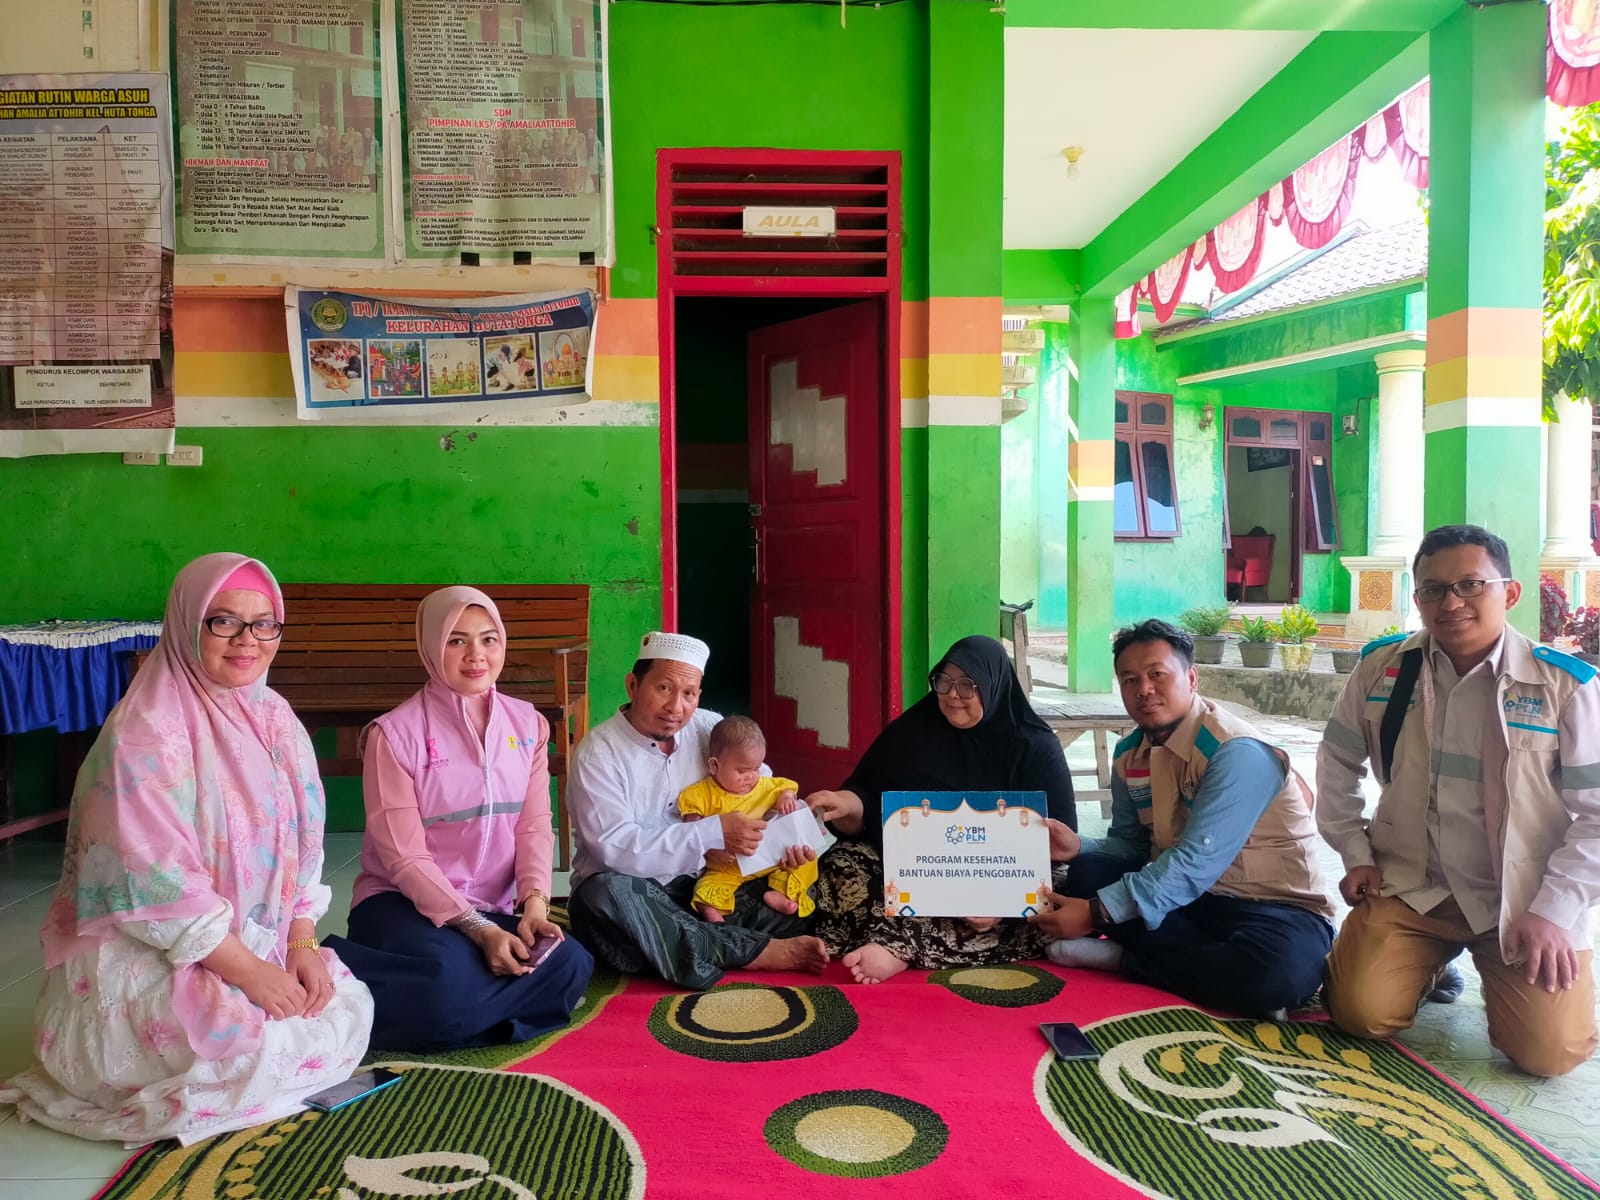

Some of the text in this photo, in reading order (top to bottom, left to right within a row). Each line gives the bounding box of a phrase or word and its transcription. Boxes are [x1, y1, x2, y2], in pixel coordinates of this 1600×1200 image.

[37, 90, 72, 104] RUTIN
[73, 89, 116, 104] WARGA
[117, 89, 149, 104] ASUH
[15, 108, 47, 118] AMALIA
[48, 107, 85, 118] ATTOHIR
[103, 107, 126, 118] HUTA
[127, 107, 156, 118] TONGA
[494, 109, 512, 118] SDM
[429, 119, 472, 128] PIMPINAN
[474, 120, 490, 129] LKS
[509, 119, 576, 129] AMALIAATTOHIR
[216, 159, 231, 167] DAN
[233, 159, 269, 168] MANFAAT
[195, 195, 213, 203] Warga
[758, 215, 819, 228] AULA
[352, 302, 373, 318] TPQ
[386, 320, 469, 334] KELURAHAN
[472, 313, 553, 332] HUTATONGA
[1517, 695, 1544, 706] YBM
[964, 826, 986, 834] YBM
[966, 834, 986, 842] PLN
[916, 855, 1017, 864] PROGRAM KESEHATAN
[899, 869, 1035, 878] BANTUAN BIAYA PENGOBATAN
